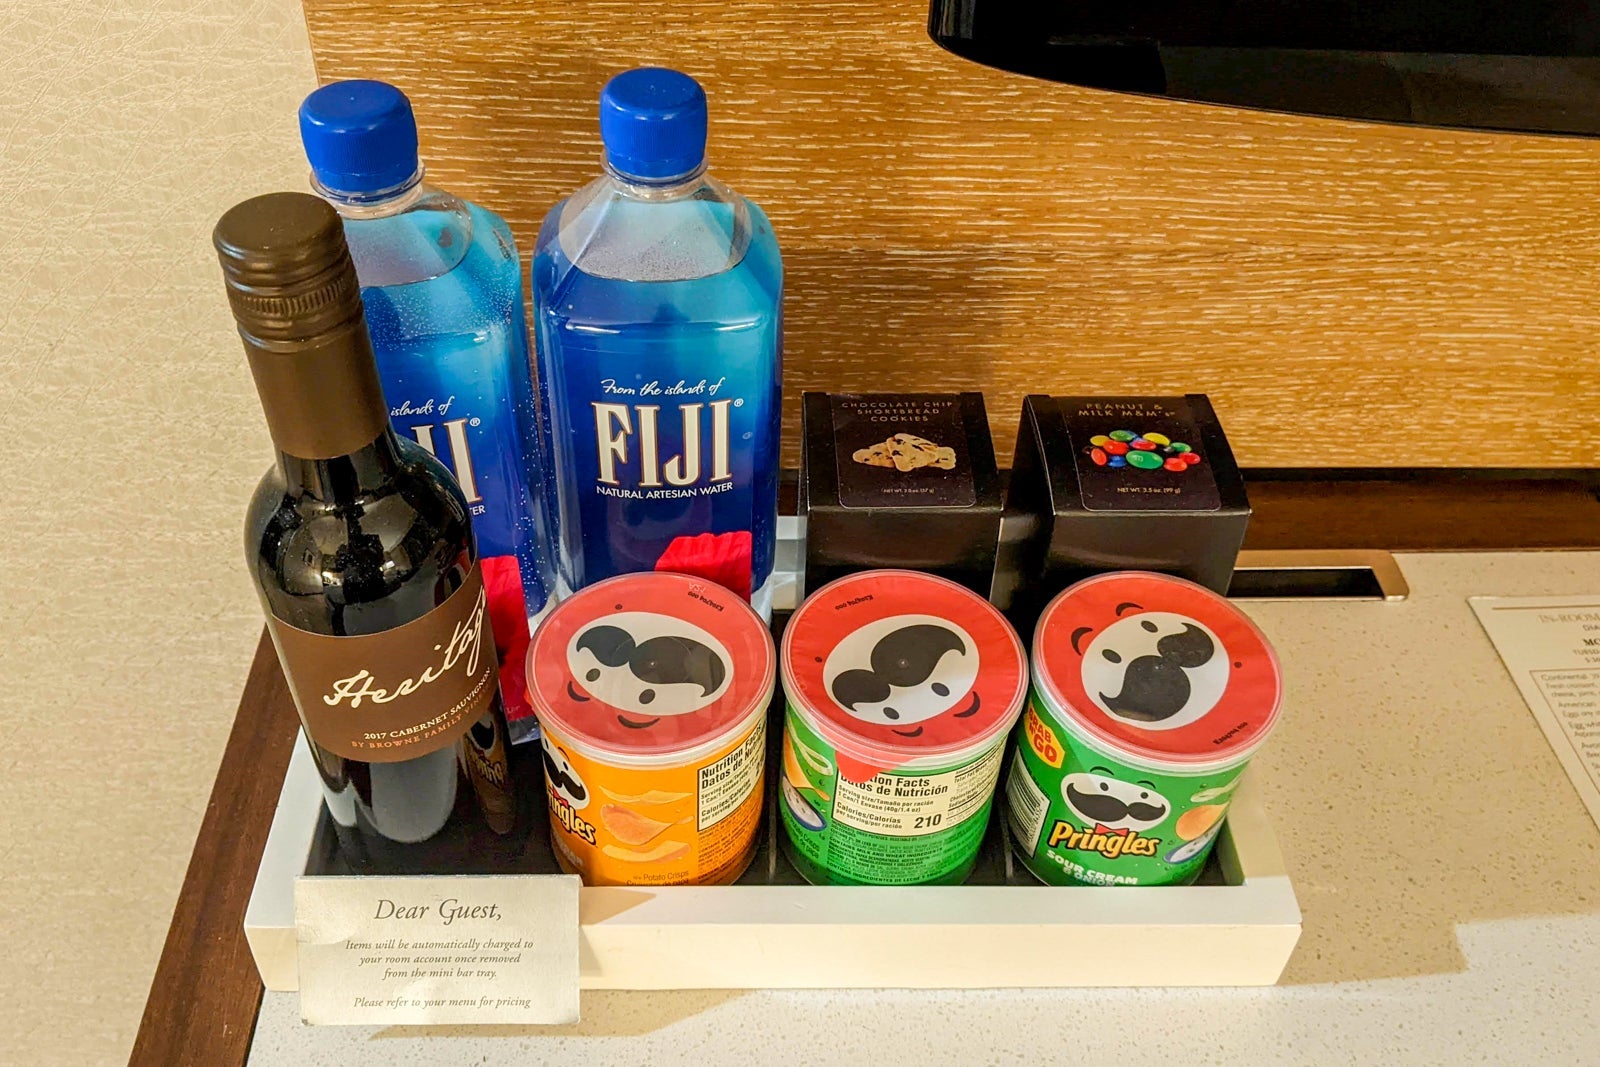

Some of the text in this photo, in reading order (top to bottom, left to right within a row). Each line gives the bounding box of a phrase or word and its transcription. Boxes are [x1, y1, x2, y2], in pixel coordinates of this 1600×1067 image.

[601, 377, 727, 397] From the islands of
[390, 396, 455, 417] islands of
[1086, 402, 1144, 410] PEANUT
[596, 481, 734, 500] NATURAL ARTESIAN WATER
[470, 503, 487, 517] TER
[364, 732, 387, 740] 2017
[389, 711, 449, 738] CABERNET
[369, 736, 421, 748] BROWNE
[424, 713, 463, 739] FAMILY
[1034, 733, 1057, 763] GO
[701, 748, 744, 780] Nutrition
[702, 768, 731, 790] Datos
[732, 758, 743, 771] de
[895, 777, 931, 788] Facts
[876, 784, 891, 796] de
[894, 784, 949, 798] Nutrición
[837, 802, 902, 824] Calories/Calorías
[914, 813, 943, 829] 210
[1047, 820, 1162, 859] Pringles
[643, 870, 689, 882] Potato Crisps
[1046, 849, 1139, 885] SOUR CREAM
[374, 897, 503, 926] Dear Guest,
[345, 938, 534, 953] Items will be automatically charged to
[358, 953, 522, 967] your room account once removed
[381, 967, 497, 981] from the mini bar tray.
[353, 995, 532, 1010] Please refer to your menu for pricing
